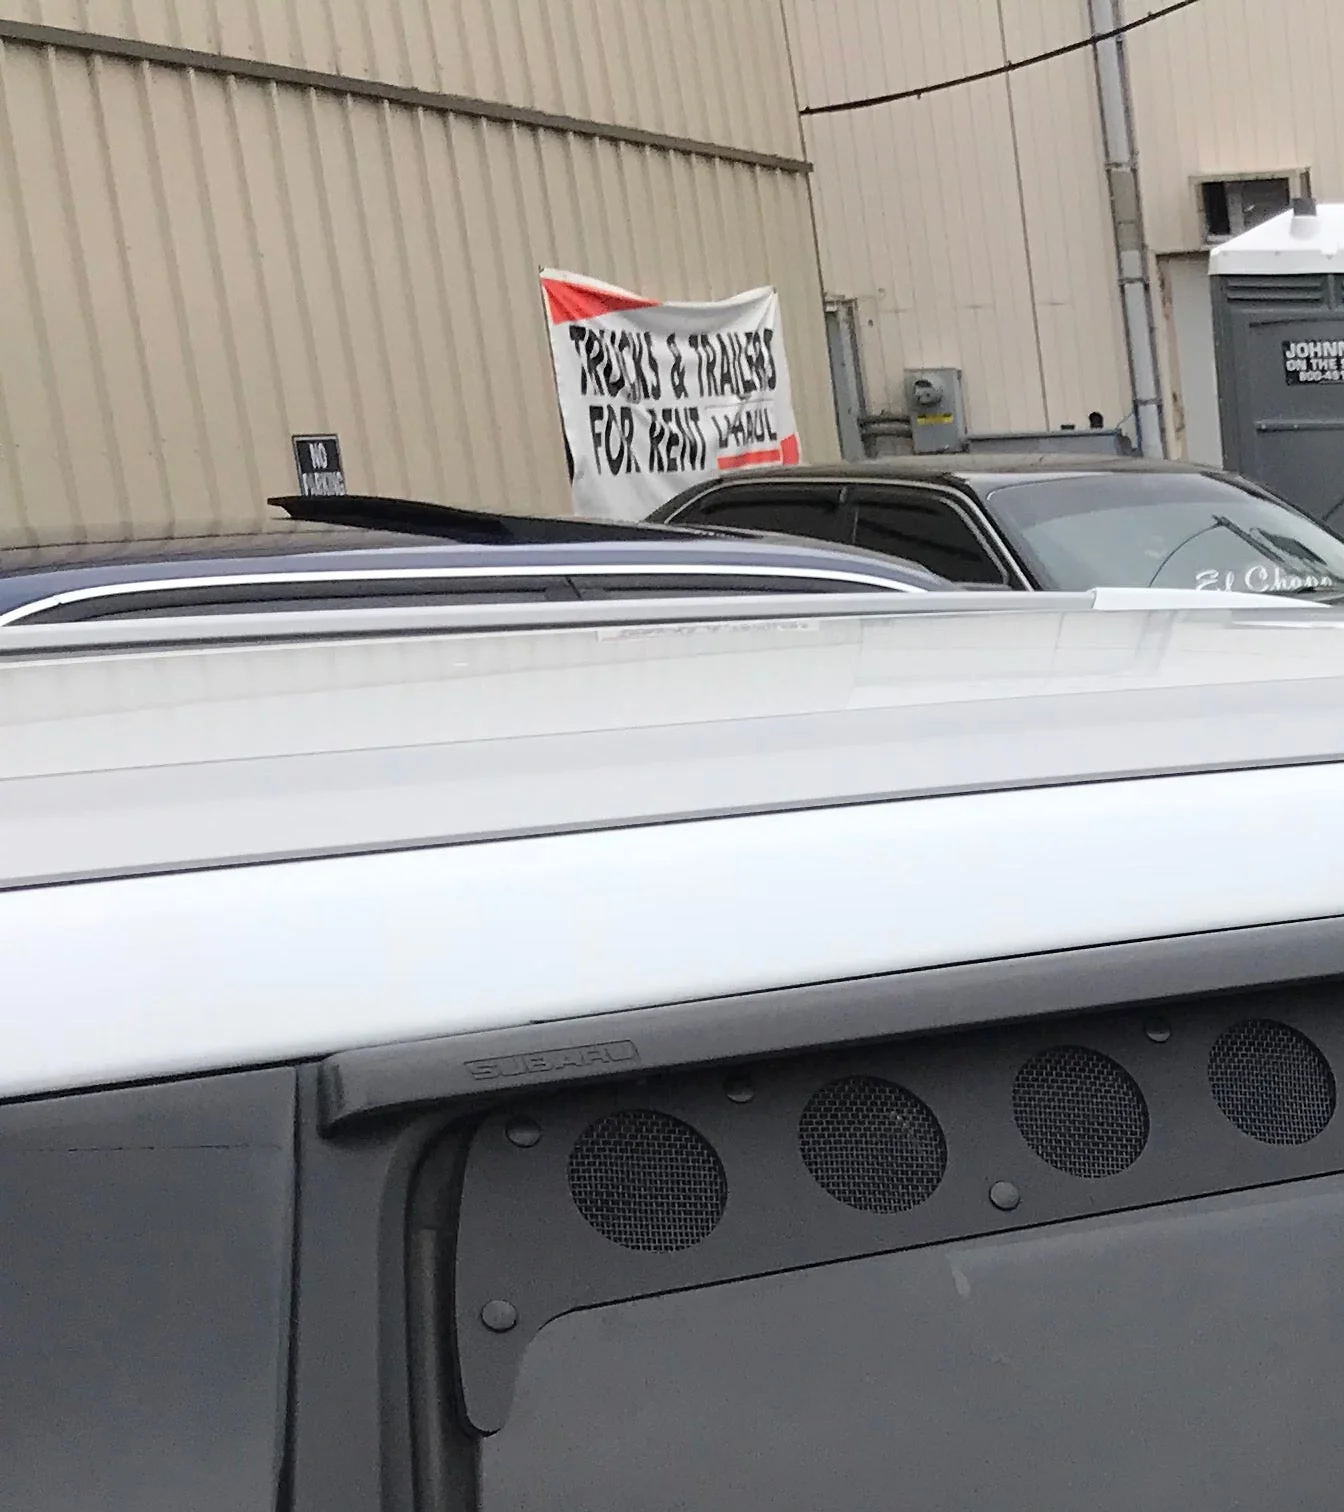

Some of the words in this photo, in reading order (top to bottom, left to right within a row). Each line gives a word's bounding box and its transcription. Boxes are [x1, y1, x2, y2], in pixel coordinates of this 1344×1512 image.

[569, 324, 661, 404] TRUCKS
[667, 332, 689, 400] &
[688, 327, 777, 397] TRAILERS
[1285, 359, 1307, 372] ON
[1310, 358, 1338, 371] THE
[309, 442, 328, 469] NO
[589, 404, 641, 476] FOR
[646, 406, 707, 474] RENT
[465, 1041, 640, 1080] SUBARU
